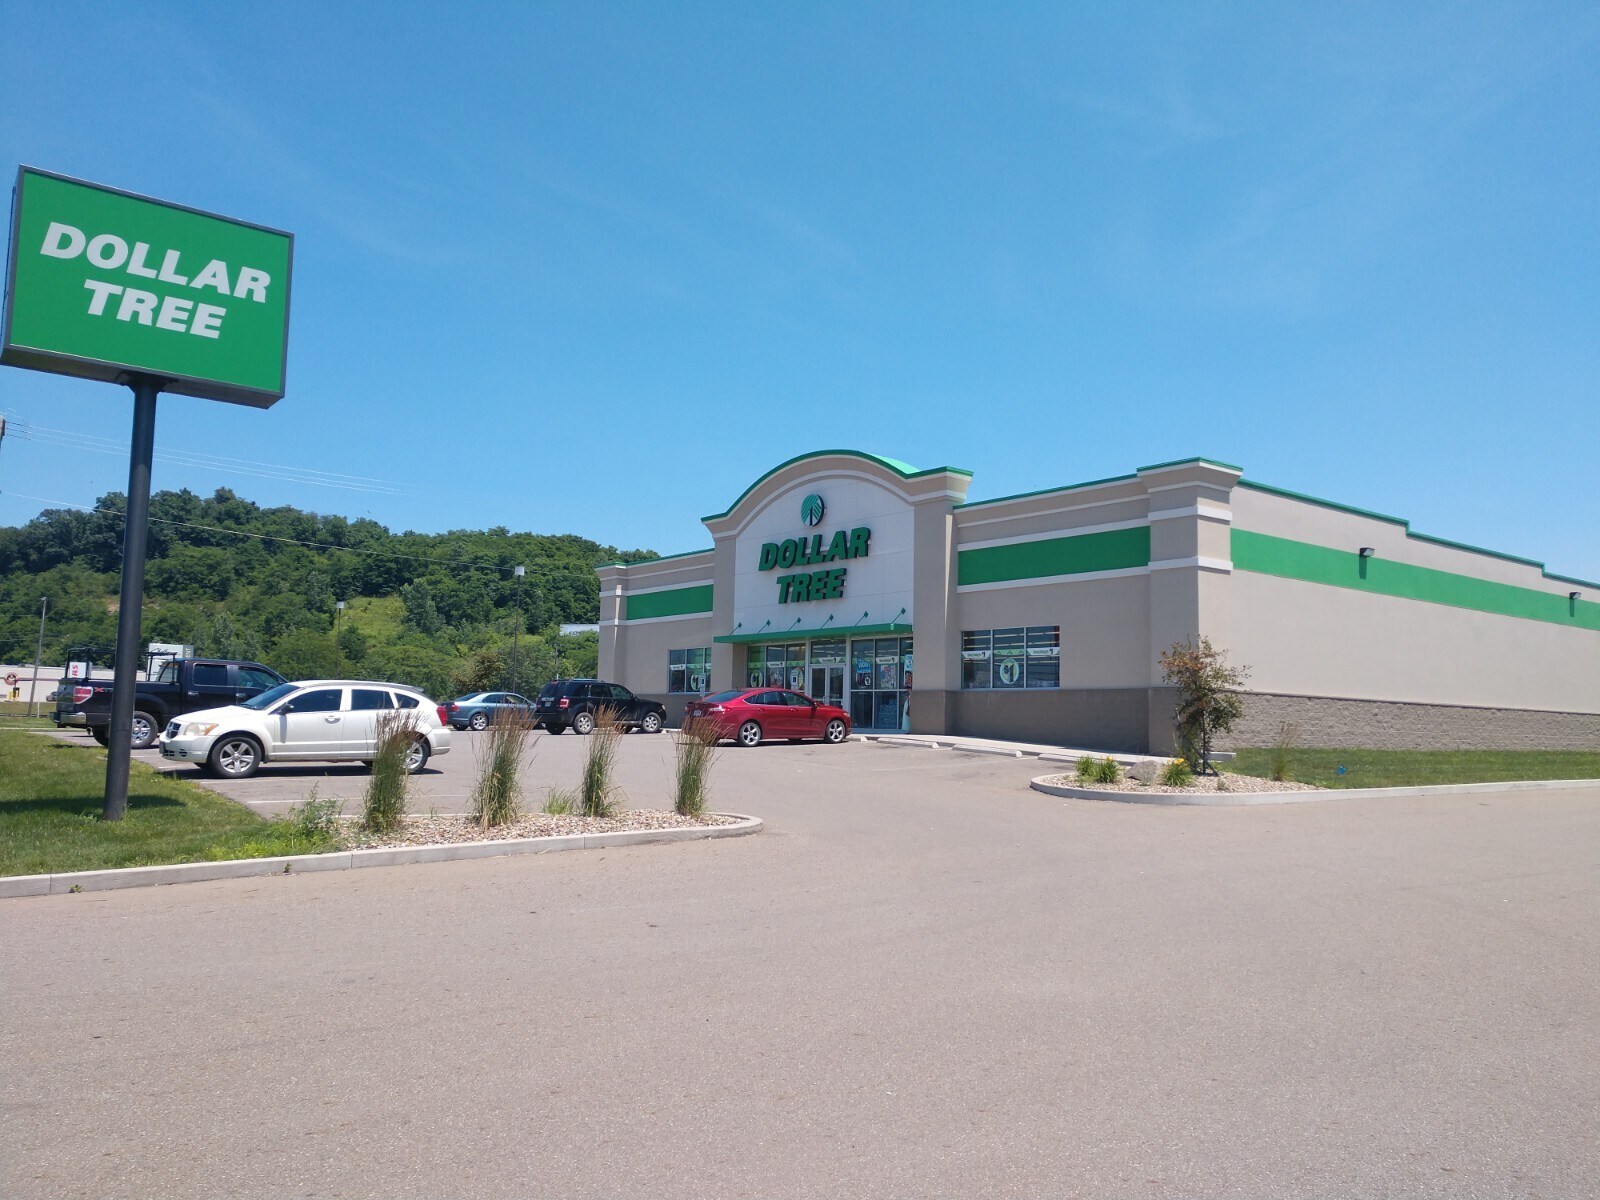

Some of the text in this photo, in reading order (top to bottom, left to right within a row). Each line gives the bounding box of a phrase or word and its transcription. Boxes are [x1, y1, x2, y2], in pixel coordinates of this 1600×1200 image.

[40, 221, 271, 303] DOLLAR
[83, 279, 227, 339] TREE
[758, 527, 871, 571] DOLLAR
[776, 568, 847, 604] TREE
